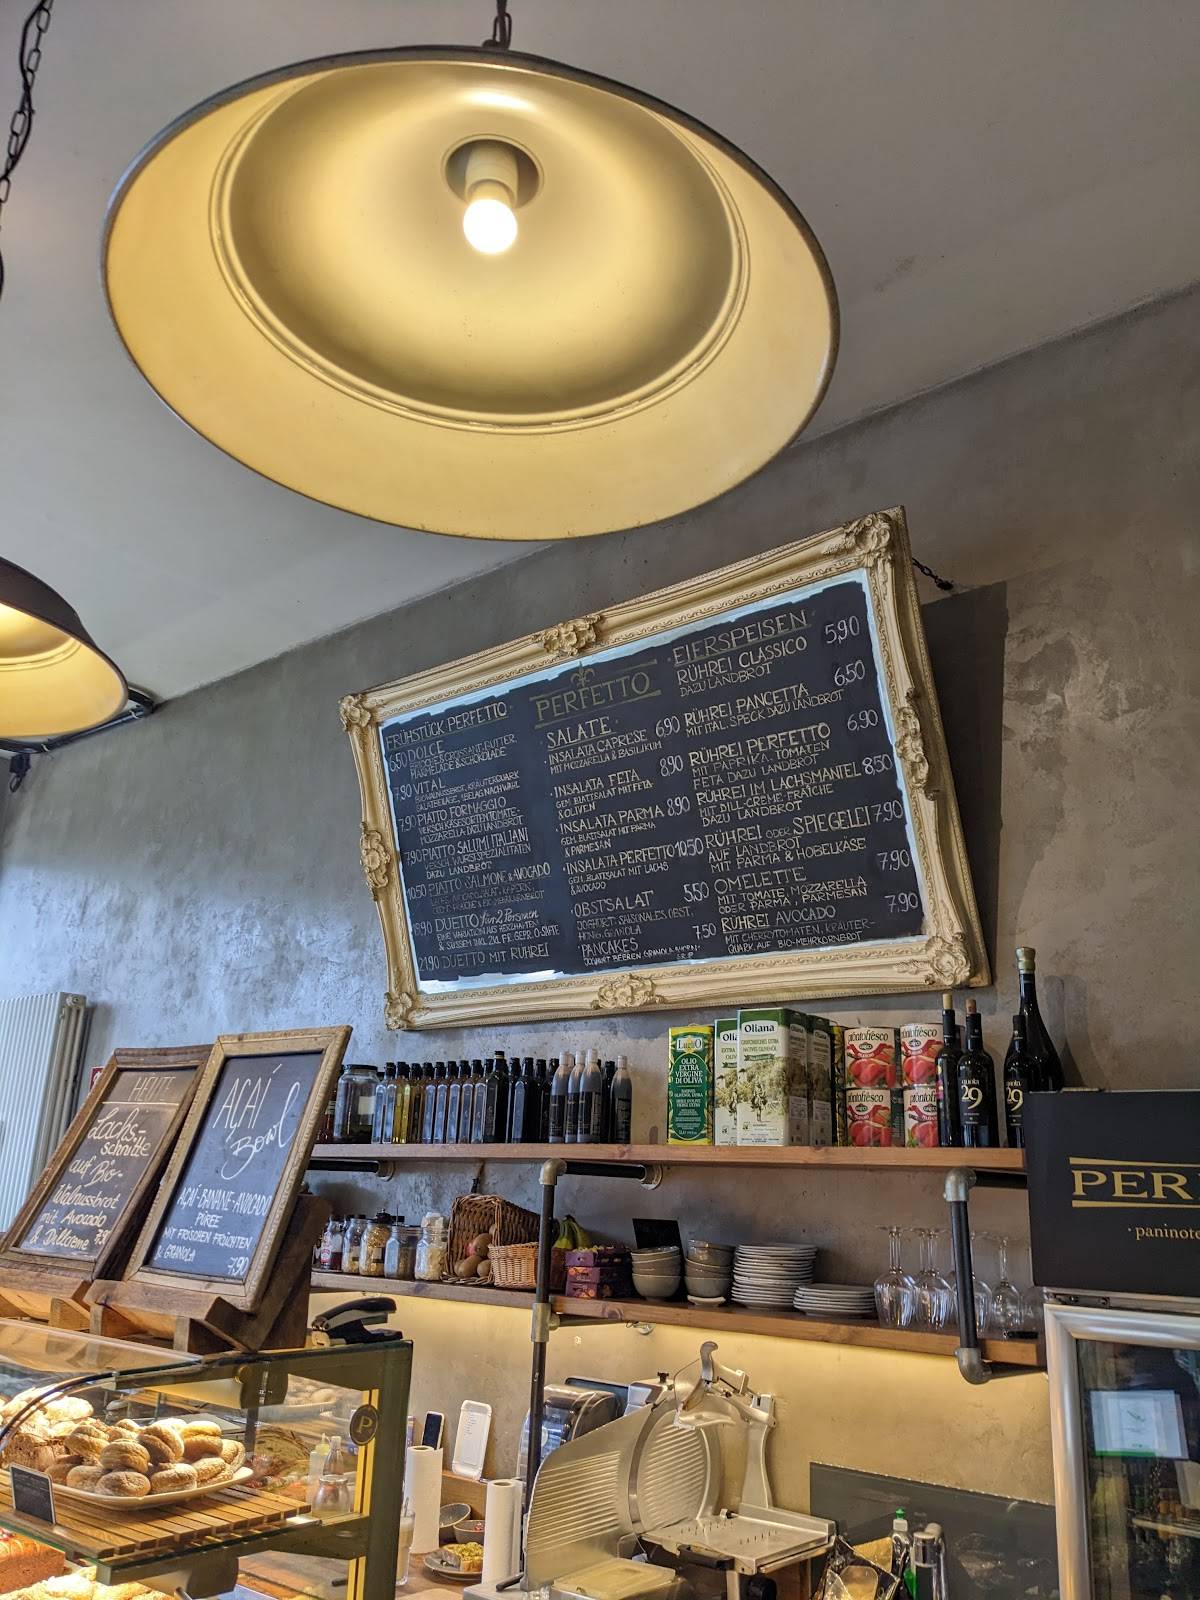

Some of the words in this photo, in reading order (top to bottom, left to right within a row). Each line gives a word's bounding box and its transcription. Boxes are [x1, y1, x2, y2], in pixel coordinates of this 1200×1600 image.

[672, 610, 808, 665] EIERSPEISEN
[825, 615, 860, 644] 5,90
[676, 657, 733, 685] RÜHREI
[738, 636, 807, 667] CLASSICO
[680, 683, 707, 698] DAZU
[708, 661, 772, 689] LANDBROT
[536, 672, 650, 722] PERFETTO
[684, 702, 733, 727] RÜHREI
[736, 683, 808, 713] PANCETTA
[386, 719, 444, 749] FRÜHSTÜCK
[448, 702, 507, 731] PERFETTO
[686, 724, 702, 738] MIT
[730, 710, 768, 727] SPECK
[768, 703, 790, 717] DAZU
[793, 688, 844, 708] LANDBROT
[847, 709, 878, 731] 6,90
[547, 716, 612, 749] SALATE
[689, 741, 743, 767] RÜHREI
[746, 722, 831, 753] PERFETTO
[408, 740, 444, 761] DOLCE
[549, 743, 595, 765] INSALATA
[597, 729, 647, 752] CAPRESE
[550, 765, 562, 775] MIT
[618, 741, 662, 759] BASILIKUM
[692, 764, 709, 778] MIT
[776, 740, 831, 759] TOMATEN
[693, 777, 724, 790] FETA
[727, 769, 757, 783] DAZU
[762, 753, 819, 775] LANDBROT
[861, 753, 892, 776] 8,50
[413, 778, 447, 794] VITAL
[554, 777, 604, 798] INSALATA
[608, 768, 640, 786] FETA
[696, 783, 746, 806] RÜHREI
[750, 781, 766, 795] IM
[771, 762, 861, 791] LACHSMANTEL
[417, 808, 448, 826] PIATTO
[450, 796, 507, 818] FORMAGGIO
[560, 814, 617, 835] INSALATA
[618, 805, 665, 823] PARMA
[700, 805, 717, 818] MIT
[703, 813, 730, 827] DAZU
[738, 800, 803, 821] LANDBROT
[630, 822, 656, 833] PARMA
[705, 824, 762, 848] RÜHREI
[766, 827, 791, 838] ODER
[793, 806, 870, 836] SPIEGELEI
[422, 844, 456, 861] PIATTO
[566, 855, 618, 875] INSALATA
[619, 843, 675, 863] PERFETTO
[708, 851, 729, 863] AUF
[737, 837, 801, 857] LANDBROT
[711, 860, 730, 873] MIT
[737, 852, 780, 869] PARMA
[785, 851, 794, 861] &
[797, 836, 866, 859] HOBELKÄSE
[877, 849, 910, 871] 7,90
[426, 870, 445, 880] DAZU
[449, 861, 492, 876] LANDBROT
[628, 866, 642, 875] MIT
[714, 867, 807, 894] OMELETTE
[574, 890, 654, 918] OBSTSALAT
[717, 893, 736, 905] MIT
[791, 876, 867, 896] MOZZARELLA
[719, 903, 745, 914] ODER
[802, 887, 867, 903] PARMESAN
[885, 892, 919, 913] 7,90
[435, 914, 479, 932] DUETTO
[497, 910, 503, 923] 2
[721, 913, 768, 932] RÜHREI
[776, 905, 836, 925] AVOCADO
[442, 951, 485, 968] DUETTO
[489, 951, 506, 963] MIT
[581, 937, 639, 958] PANCAKES
[744, 1024, 775, 1033] Oliana
[961, 1085, 983, 1110] 29
[69, 1156, 97, 1179] auf
[1072, 1170, 1200, 1200] PER
[61, 1209, 107, 1226] Avocado
[357, 1418, 373, 1433] P
